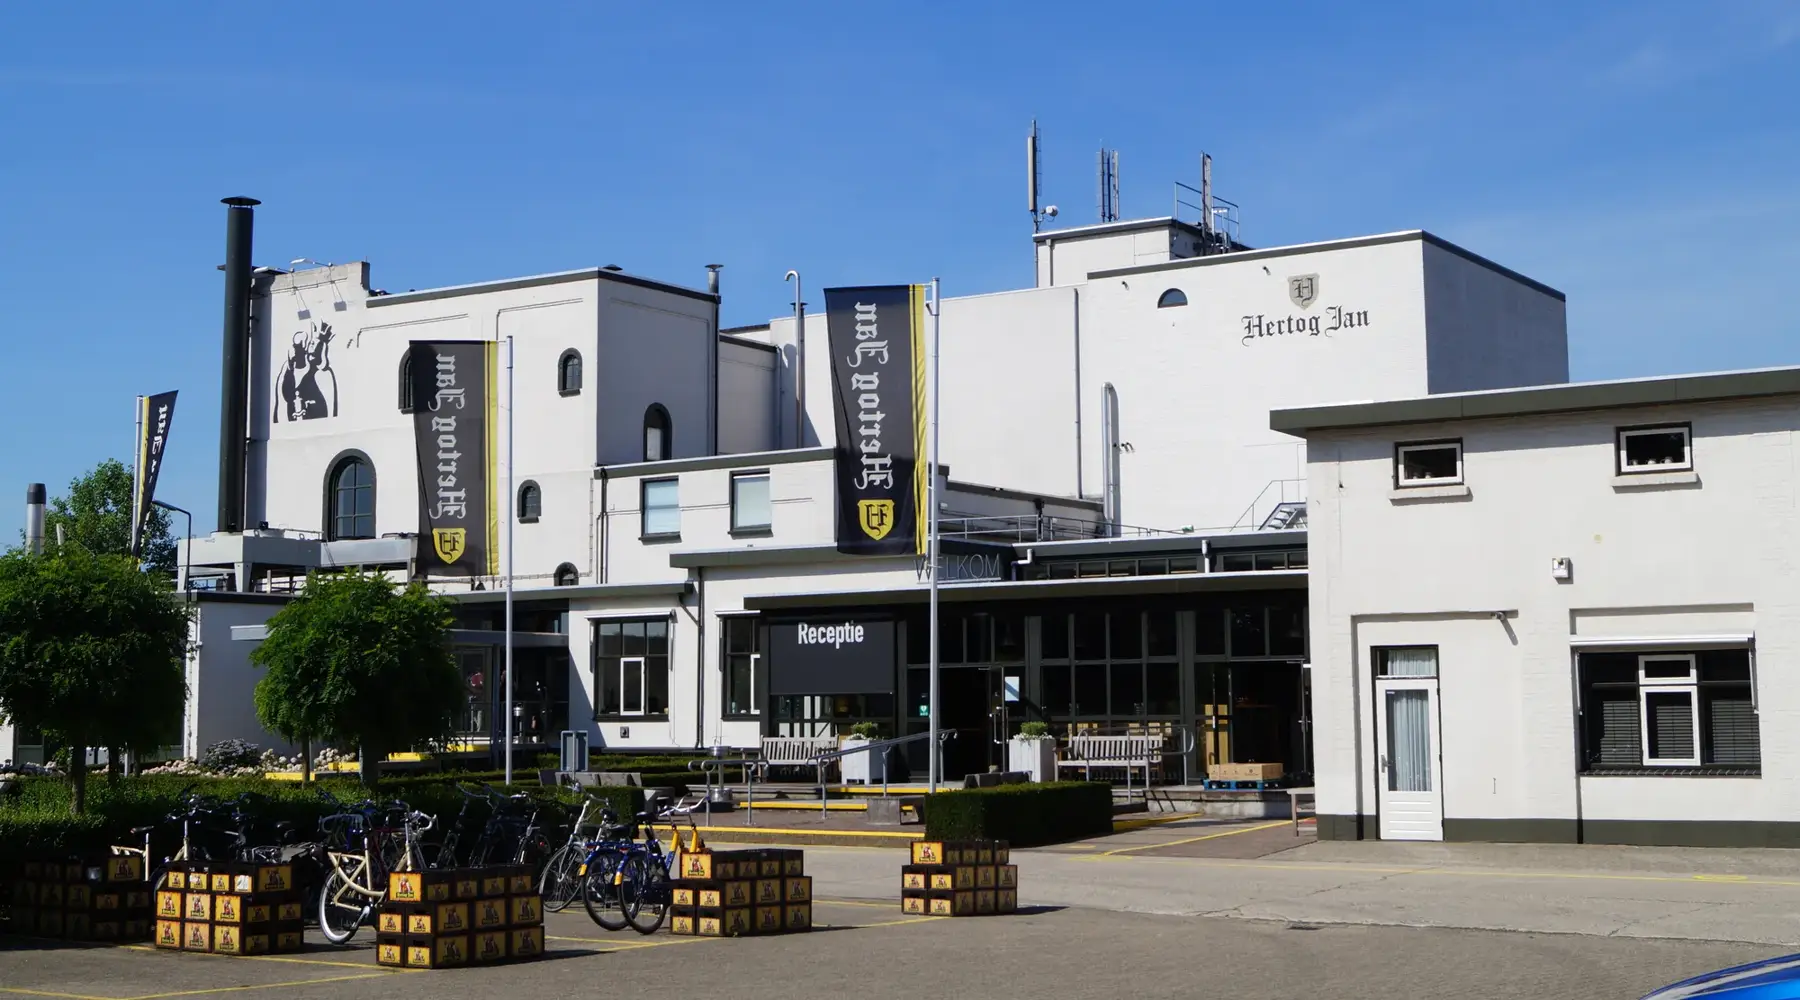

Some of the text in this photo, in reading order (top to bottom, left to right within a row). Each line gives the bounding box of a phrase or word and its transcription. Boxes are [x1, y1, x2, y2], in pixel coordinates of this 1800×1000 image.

[1241, 305, 1371, 347] Hertog Jan
[798, 621, 864, 649] Receptie
